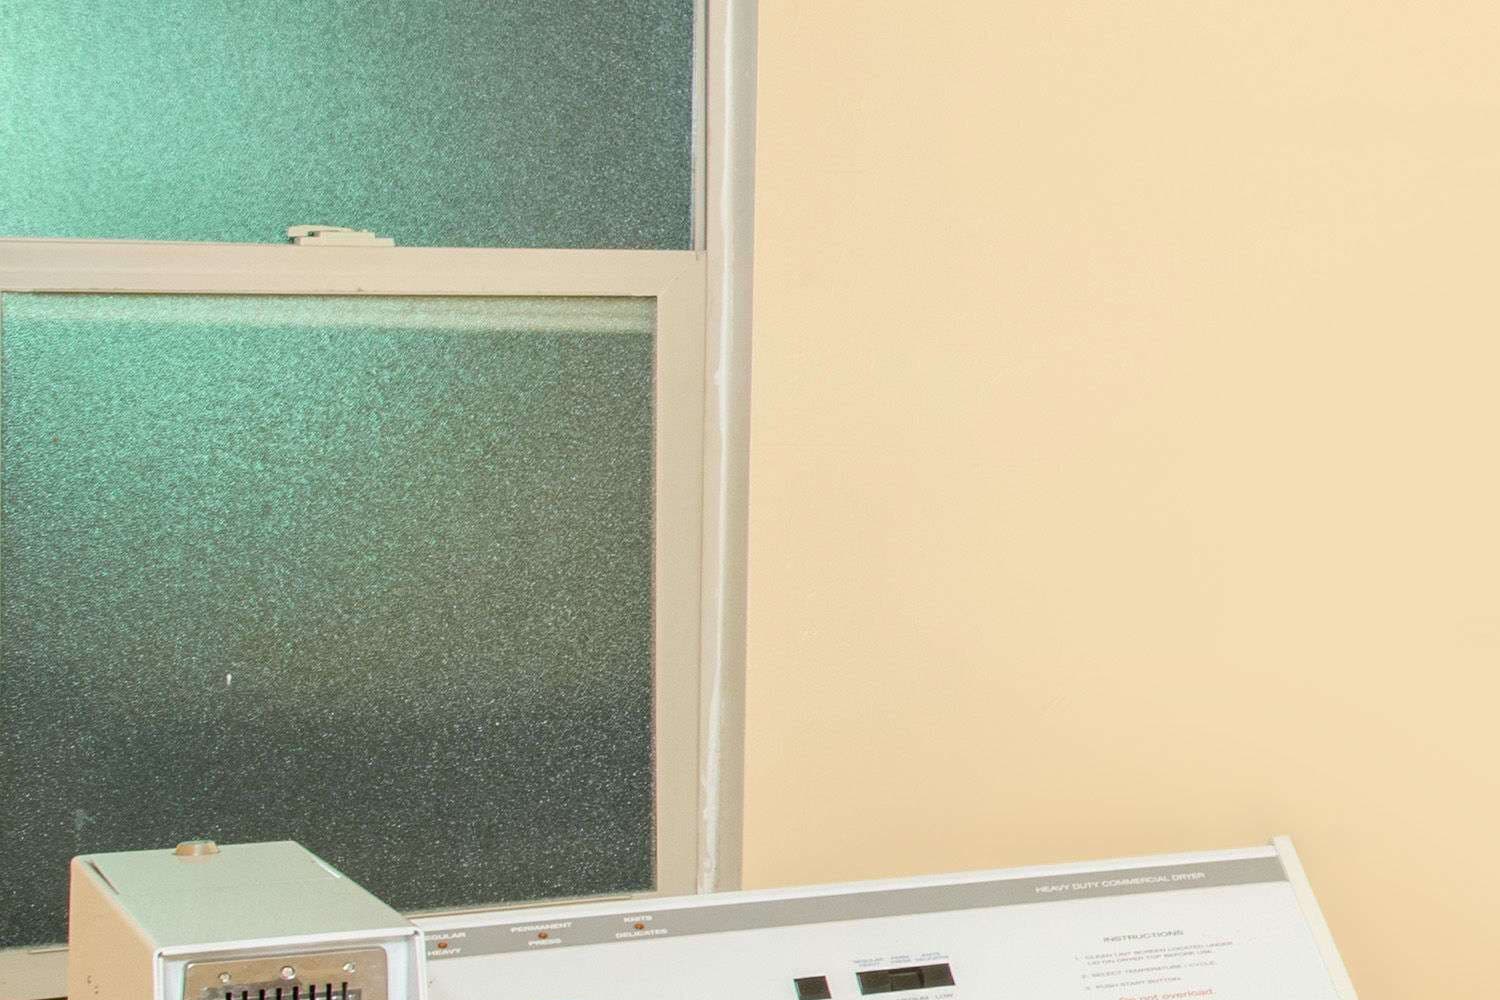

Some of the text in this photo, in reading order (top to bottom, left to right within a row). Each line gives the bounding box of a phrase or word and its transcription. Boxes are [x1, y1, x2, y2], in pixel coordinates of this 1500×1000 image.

[1035, 872, 1206, 893] HEAVY DUTY COMMERCIAL DRYER
[510, 921, 573, 933] PERMANENT
[616, 928, 668, 939] DELICATES
[1103, 930, 1184, 943] INSTRUCTIONS
[428, 948, 461, 956] HEAVY
